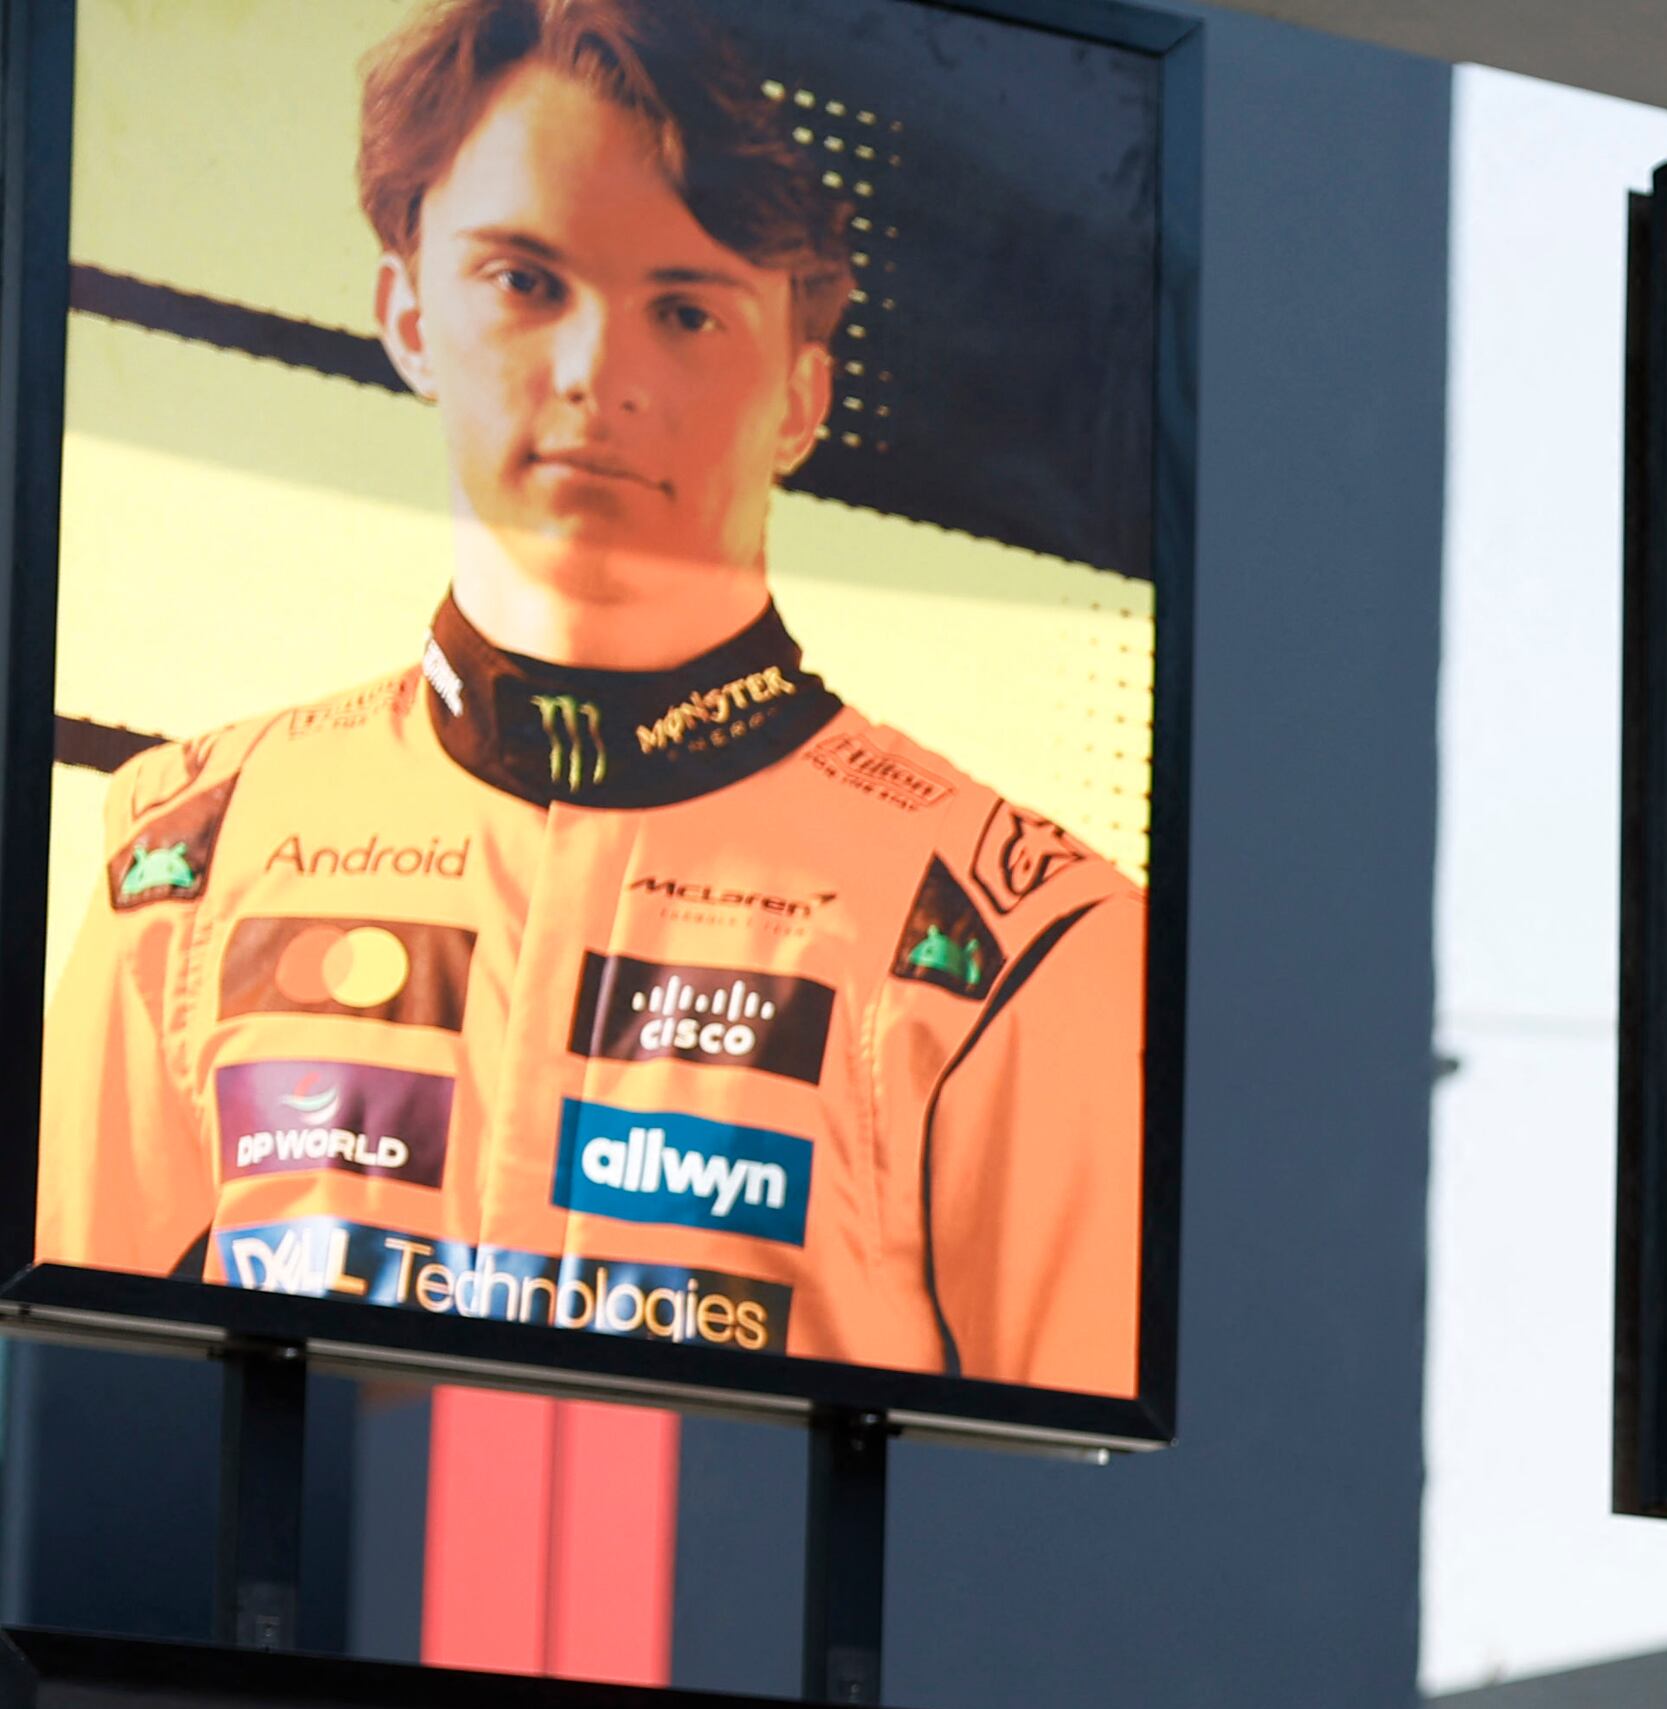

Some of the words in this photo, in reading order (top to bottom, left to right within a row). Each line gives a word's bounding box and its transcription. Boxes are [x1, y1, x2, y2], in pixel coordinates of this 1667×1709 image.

[265, 834, 472, 879] Android
[629, 876, 812, 917] McLaren
[640, 1017, 756, 1056] cisco
[236, 1128, 274, 1168] DP
[276, 1128, 409, 1168] WORLD
[581, 1127, 787, 1217] allwyn
[231, 1226, 367, 1298] DELL
[384, 1239, 769, 1351] Technologies
